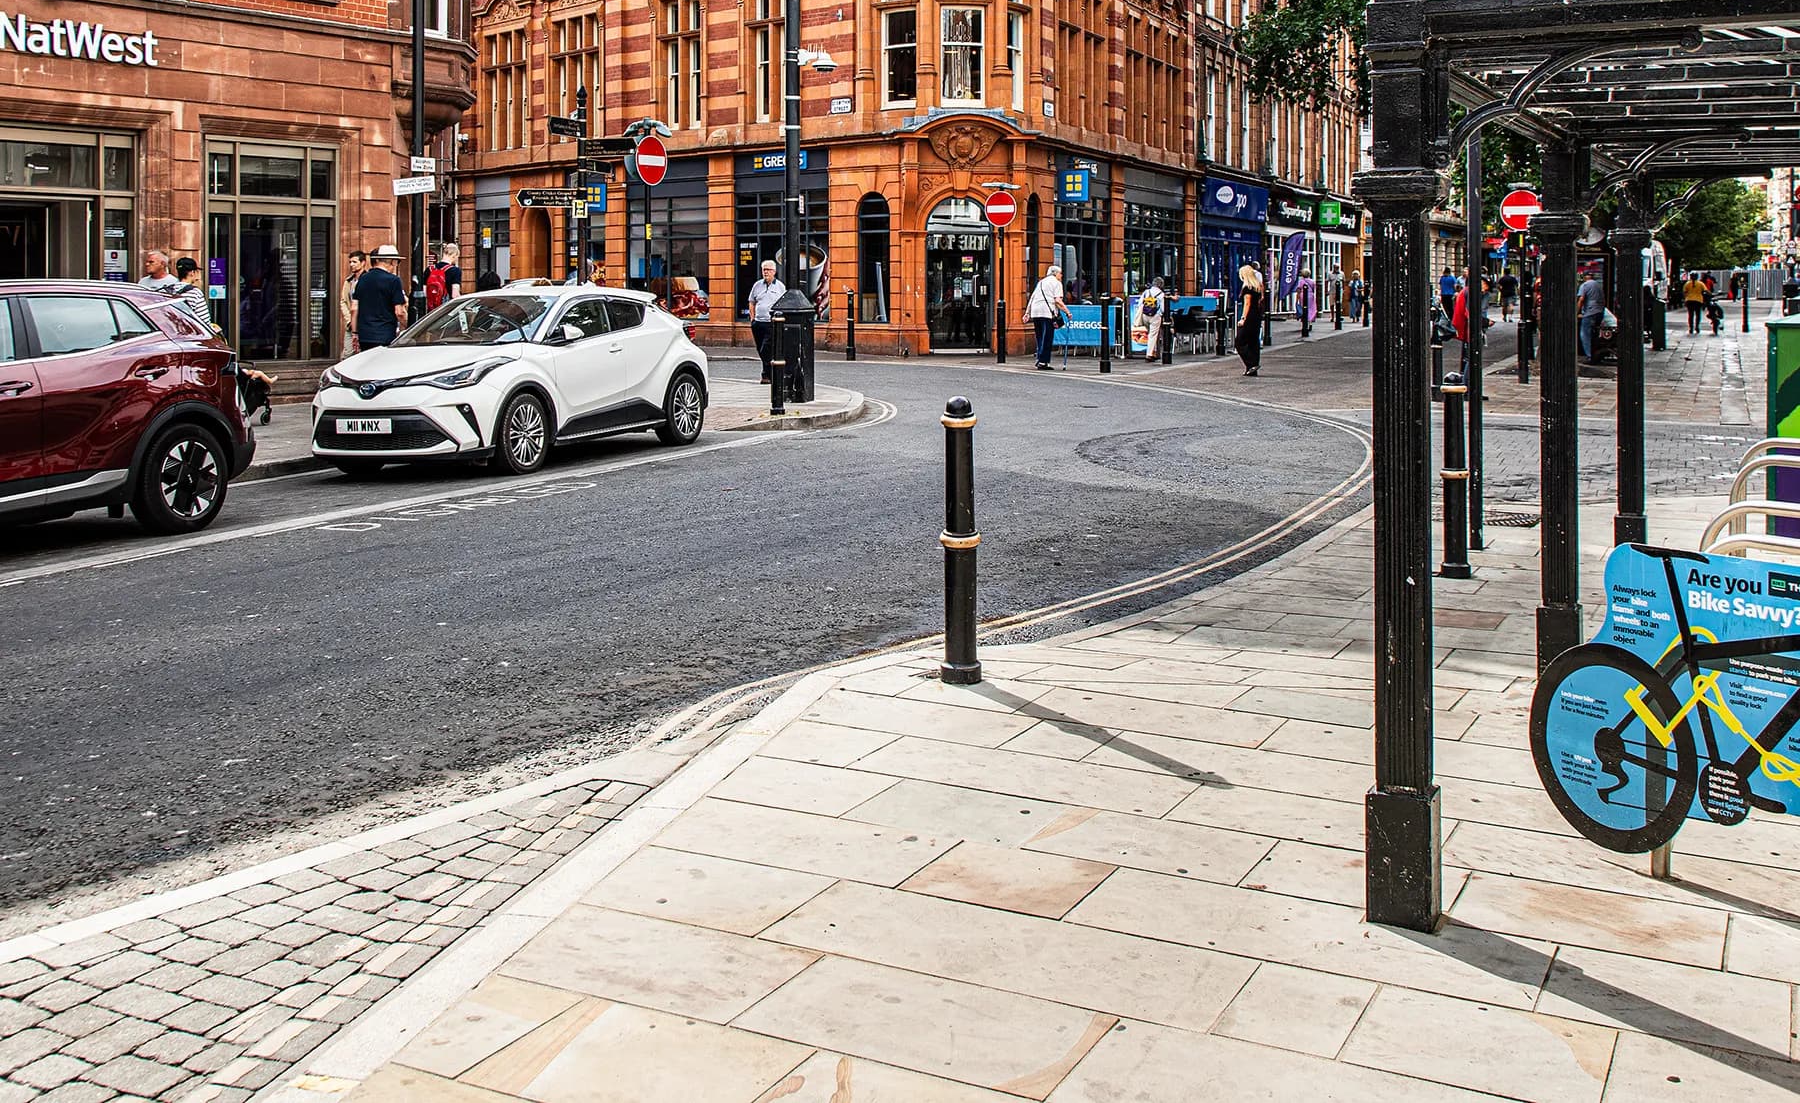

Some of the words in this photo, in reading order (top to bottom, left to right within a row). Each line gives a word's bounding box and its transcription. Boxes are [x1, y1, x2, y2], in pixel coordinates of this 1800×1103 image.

[0, 11, 158, 66] NatWest
[1285, 252, 1294, 283] evapo
[1069, 321, 1102, 330] GREGGS
[361, 420, 380, 431] WNX
[316, 481, 597, 531] DISABLED
[1687, 569, 1721, 589] Are
[1724, 577, 1761, 595] you
[1613, 584, 1640, 596] Always
[1641, 588, 1656, 598] lock
[1631, 597, 1648, 607] bike
[1612, 603, 1634, 614] frame
[1636, 609, 1650, 617] and
[1652, 610, 1670, 621] both
[1688, 590, 1730, 614] Bike
[1733, 597, 1800, 628] Savvy?
[1613, 615, 1640, 626] wheels
[1640, 619, 1648, 627] to
[1613, 624, 1654, 639] immovable
[1613, 634, 1636, 645] object
[1729, 667, 1748, 675] stands
[1755, 672, 1770, 680] park
[1729, 681, 1743, 689] Visit
[1736, 691, 1748, 699] find
[1592, 704, 1609, 715] leaving
[1729, 699, 1749, 708] quality
[1750, 702, 1762, 710] lock
[1709, 775, 1722, 783] park
[1722, 779, 1736, 787] your
[1708, 781, 1721, 789] bike
[1721, 786, 1740, 795] where
[1708, 790, 1724, 799] there
[1729, 796, 1744, 805] good
[1708, 799, 1725, 807] street
[1725, 801, 1746, 814] lighting
[1720, 809, 1735, 818] CCTV
